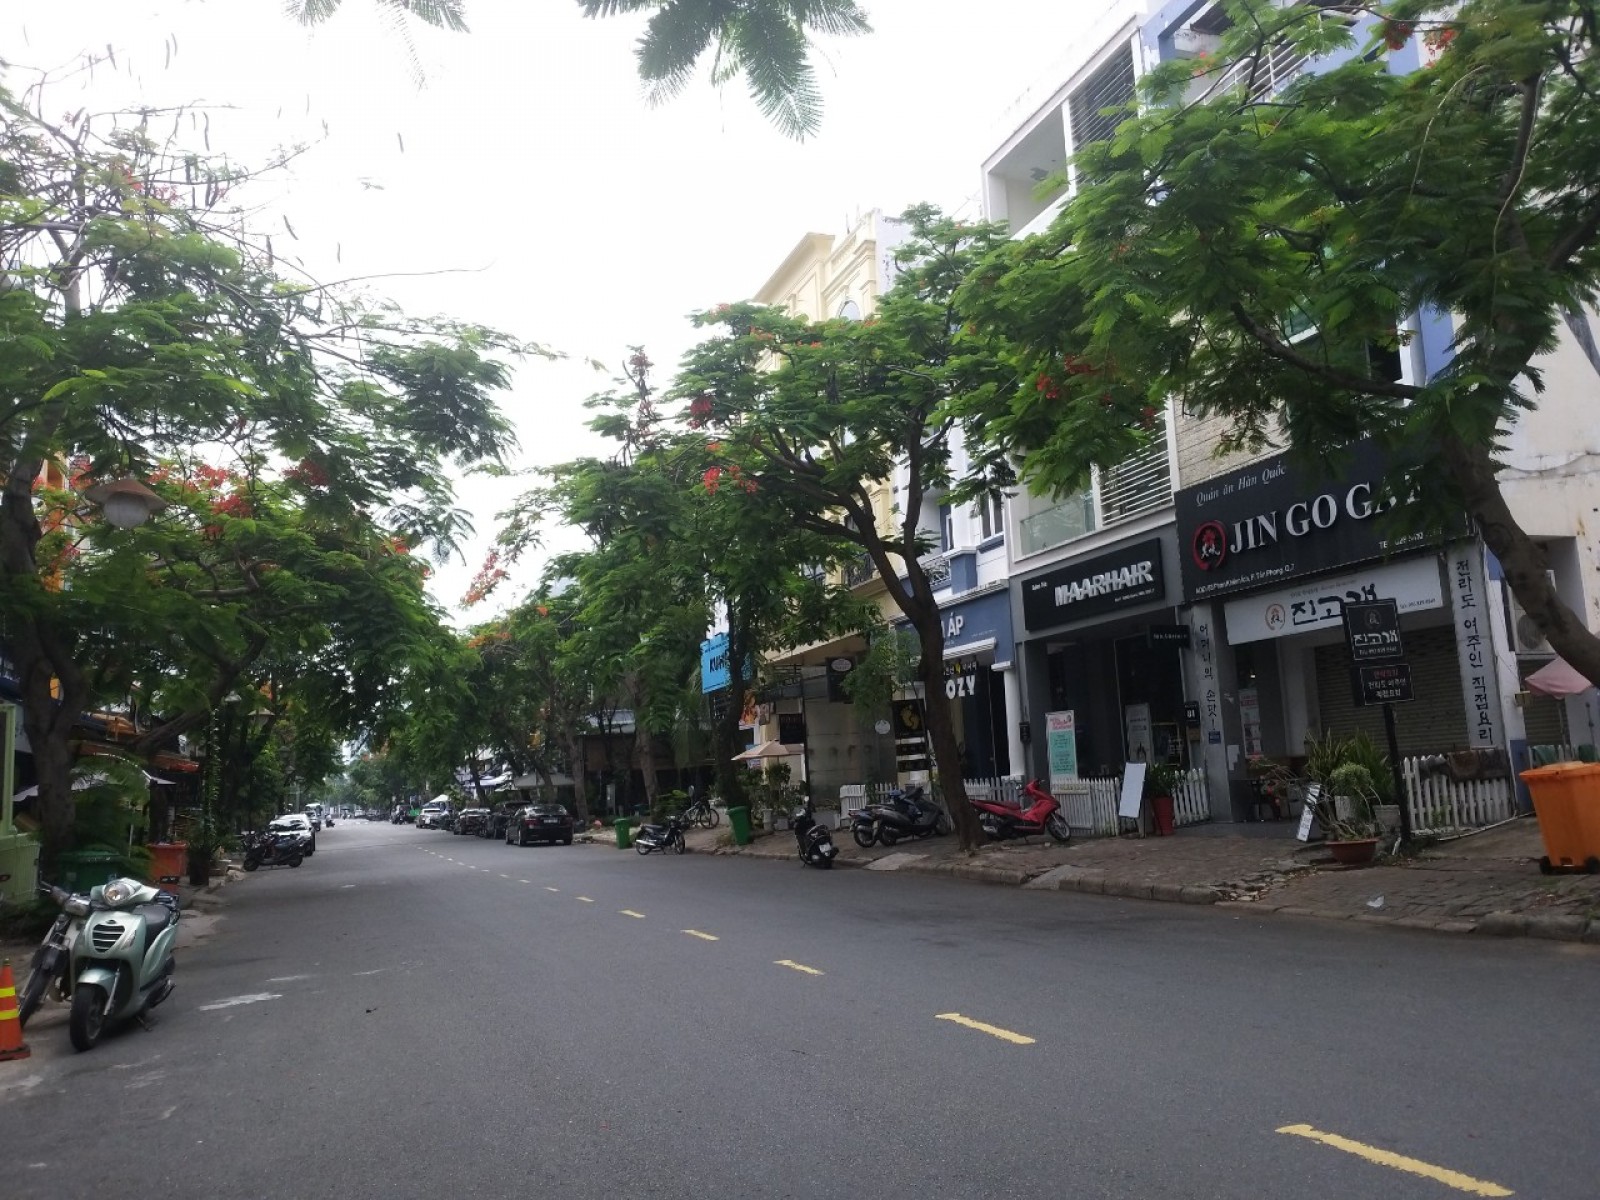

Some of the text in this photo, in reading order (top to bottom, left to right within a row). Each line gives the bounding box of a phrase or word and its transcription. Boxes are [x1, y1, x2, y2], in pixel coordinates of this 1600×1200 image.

[1196, 487, 1219, 507] Quán
[1230, 511, 1278, 554] JIN
[1285, 494, 1338, 537] GO
[1054, 560, 1154, 606] MAARHAIR
[947, 612, 964, 637] ÁP
[1456, 559, 1493, 746] 전라도 여주인 직접요리
[945, 675, 976, 699] OZY
